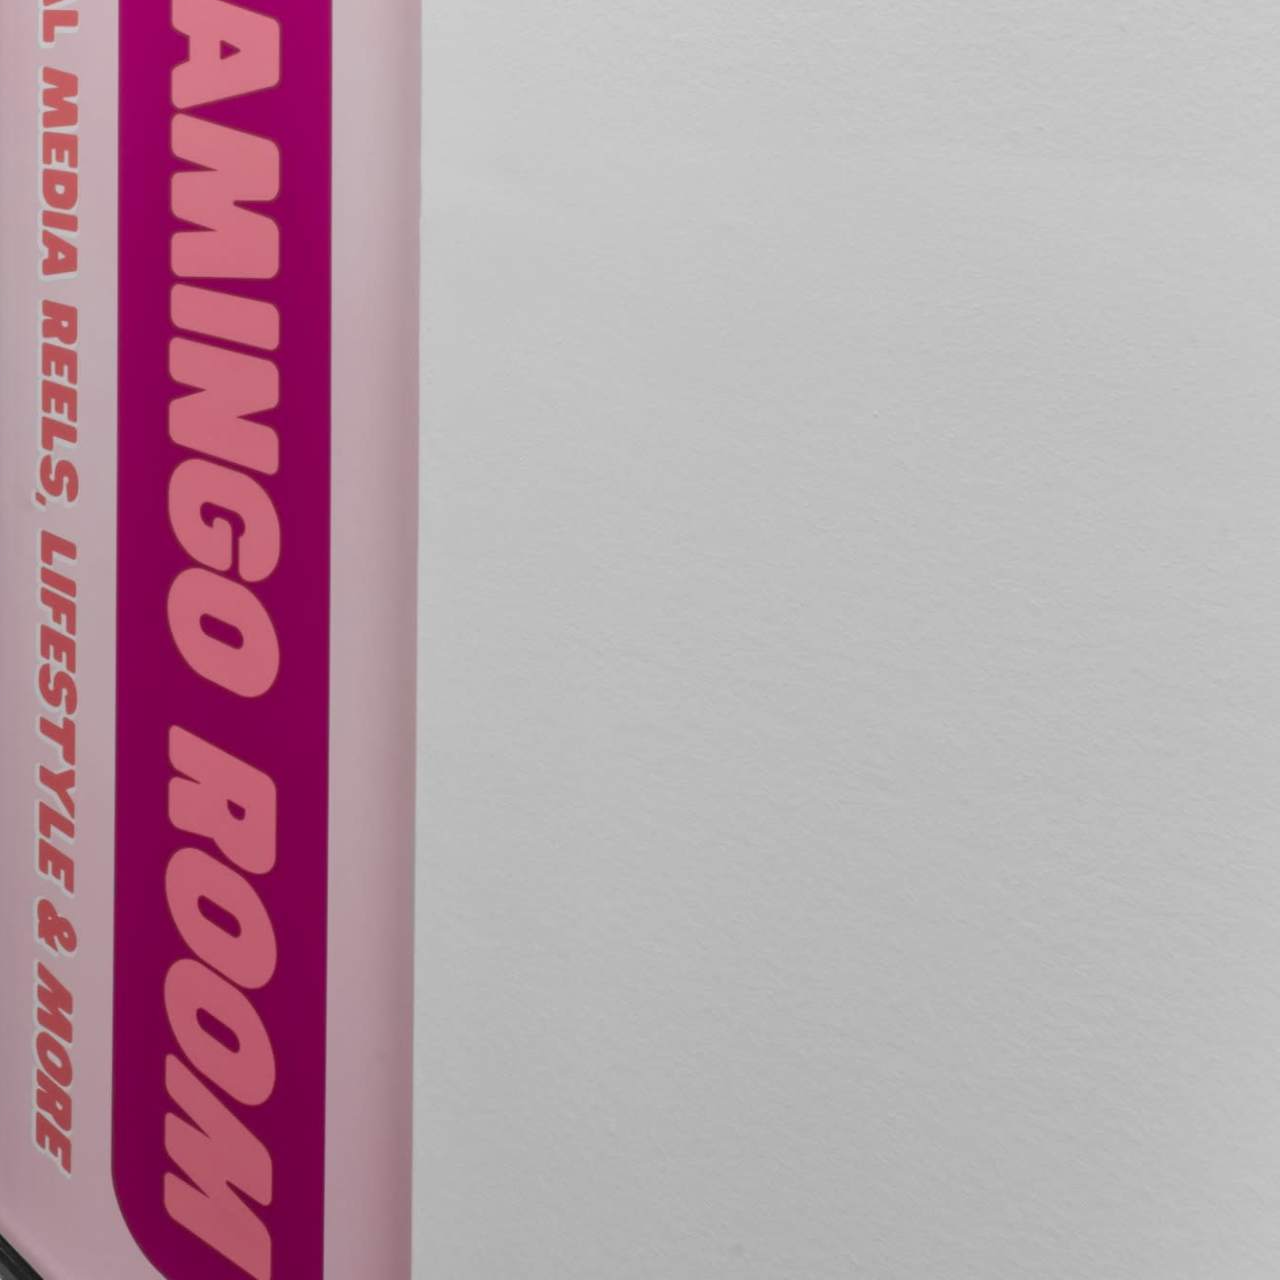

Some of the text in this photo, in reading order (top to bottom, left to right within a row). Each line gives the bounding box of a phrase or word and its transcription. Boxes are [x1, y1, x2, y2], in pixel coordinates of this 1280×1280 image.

[42, 67, 79, 275] MEDIA
[37, 302, 78, 507] REELS,
[38, 532, 77, 891] LIFESTYLE
[38, 900, 77, 950] &
[163, 724, 278, 1280] ROOM
[36, 963, 73, 1174] MORE
